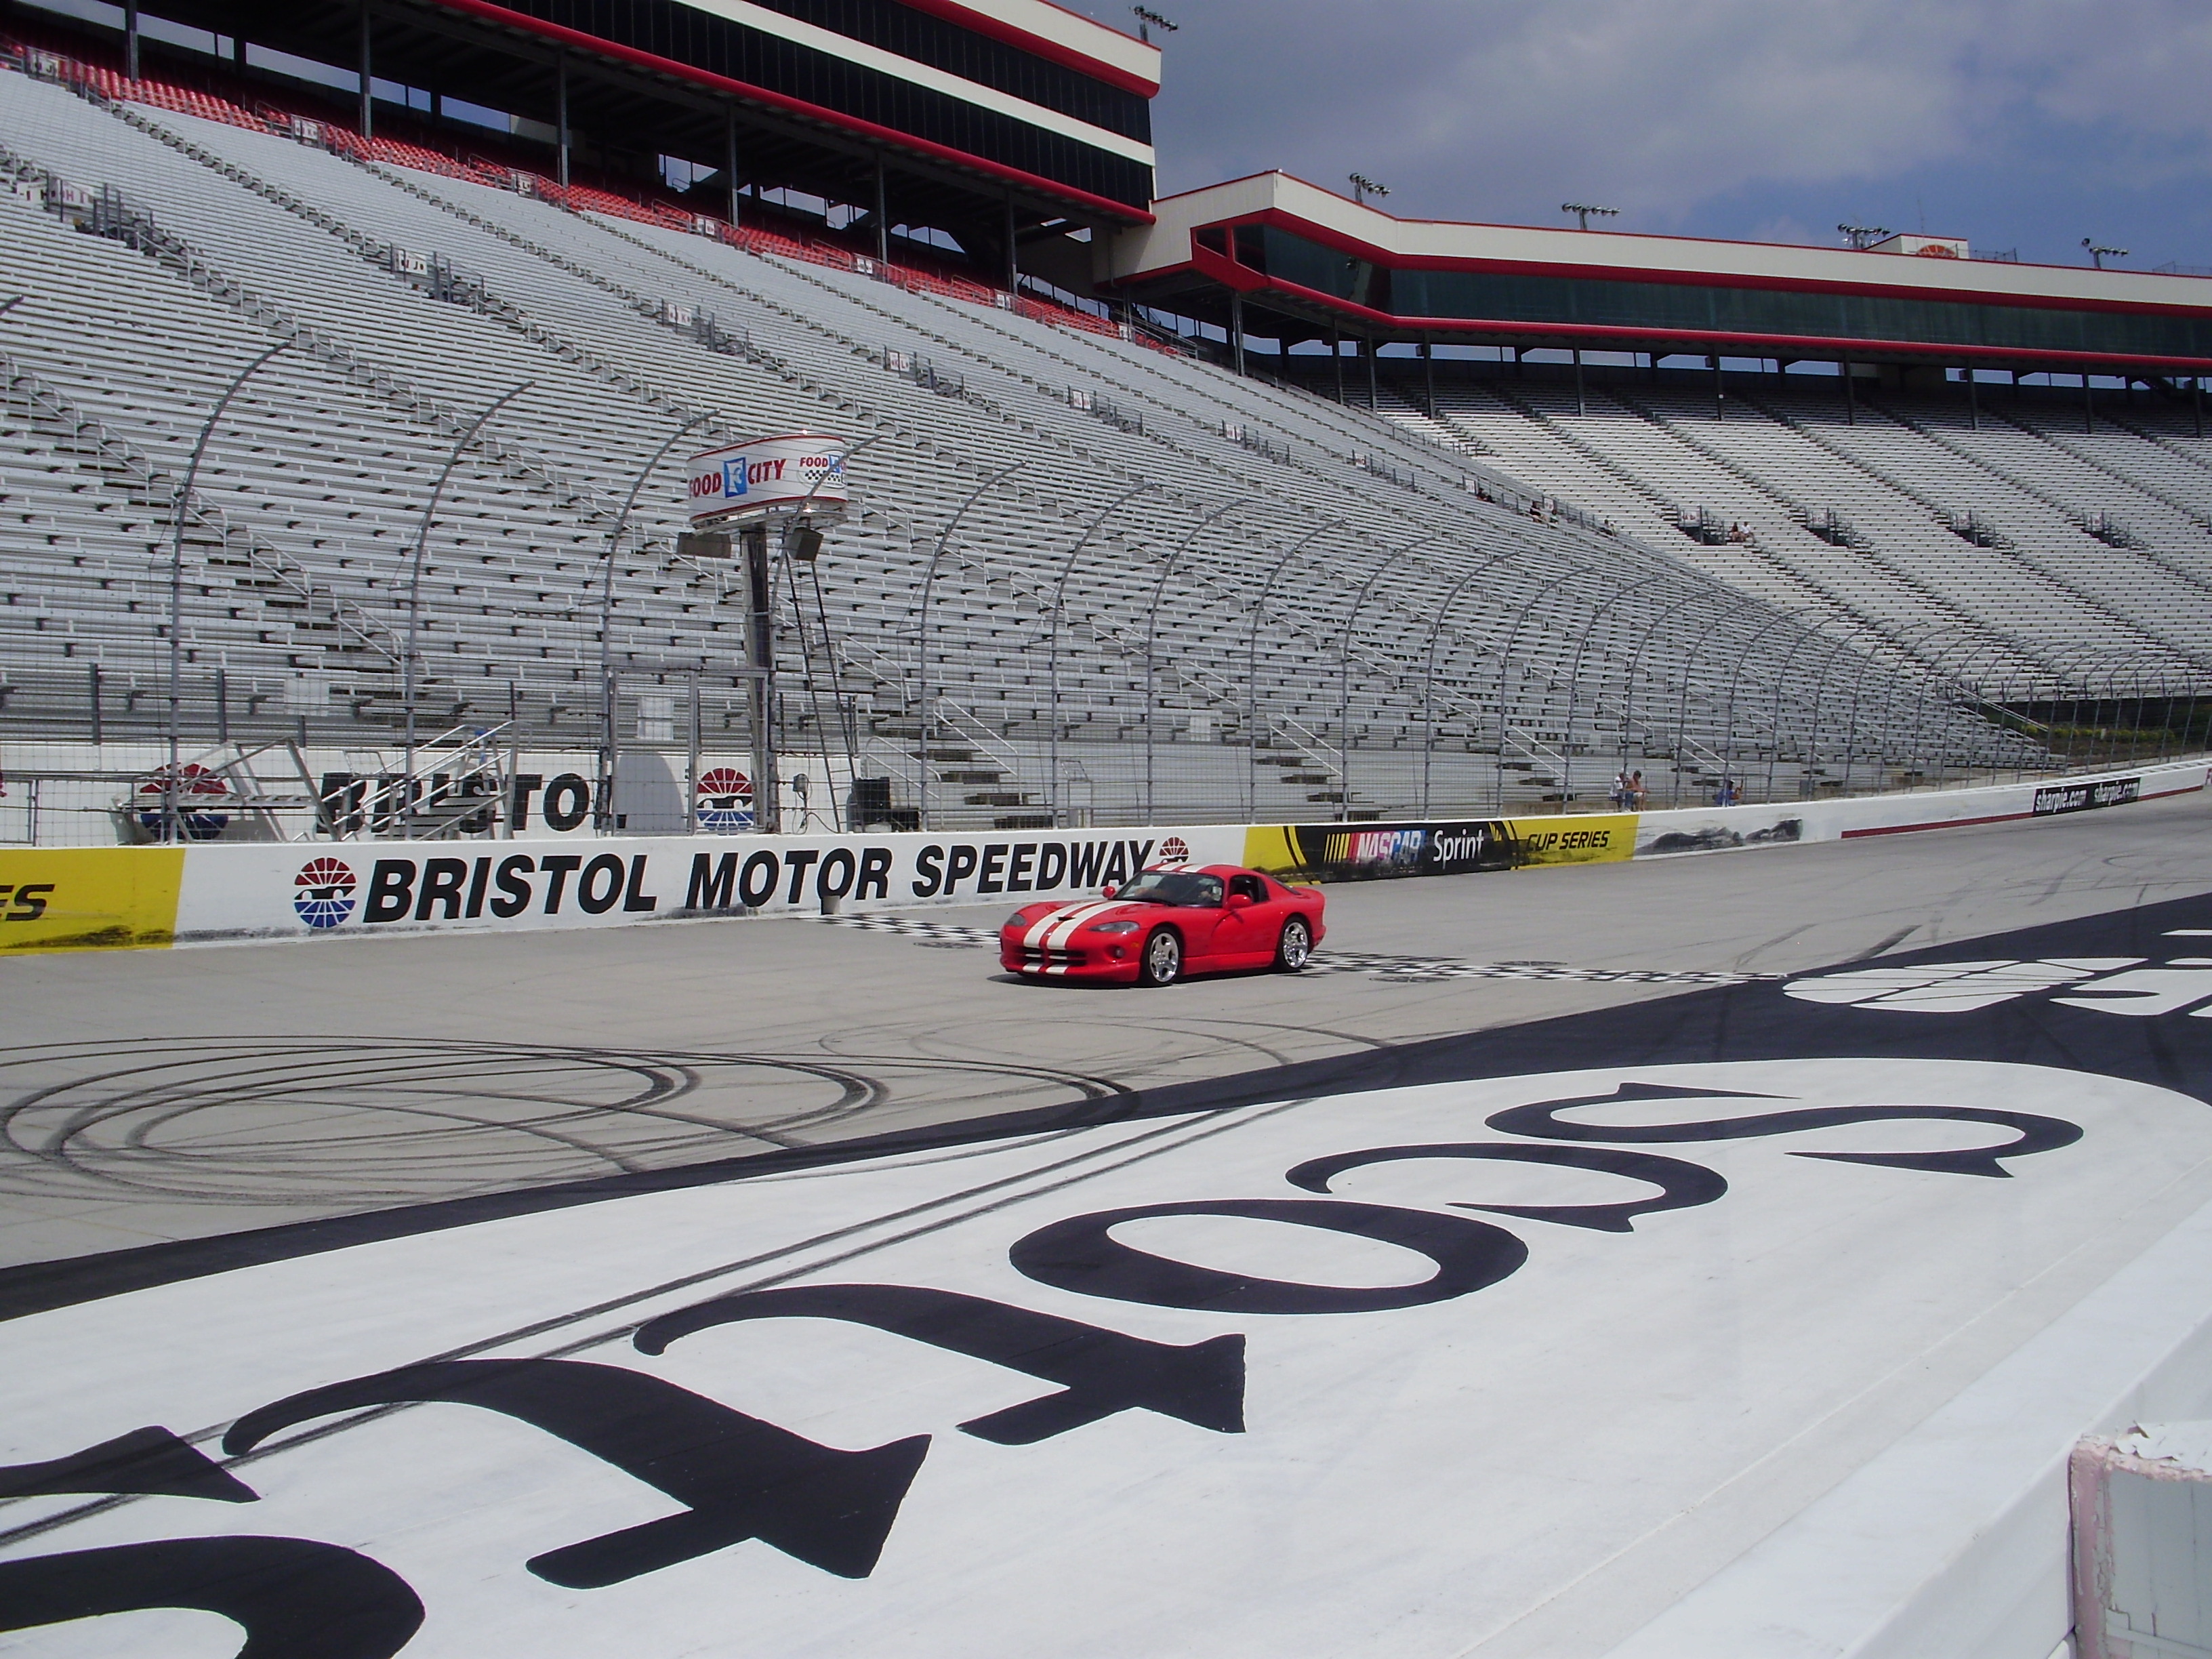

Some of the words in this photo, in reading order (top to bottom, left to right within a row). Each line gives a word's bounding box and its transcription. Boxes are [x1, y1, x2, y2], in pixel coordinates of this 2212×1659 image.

[747, 458, 787, 485] CITY
[799, 456, 828, 468] FOOD
[2035, 787, 2087, 813] sharpie.com
[2093, 780, 2139, 806] sharpie.com
[1355, 830, 1422, 864] NASCAR
[1433, 828, 1485, 869] Sprint
[1528, 833, 1559, 851] CUP
[1559, 830, 1610, 851] SERIES
[363, 854, 657, 923] BRISTOL
[684, 847, 893, 910] MOTOR
[912, 839, 1156, 898] SPEEDWAY
